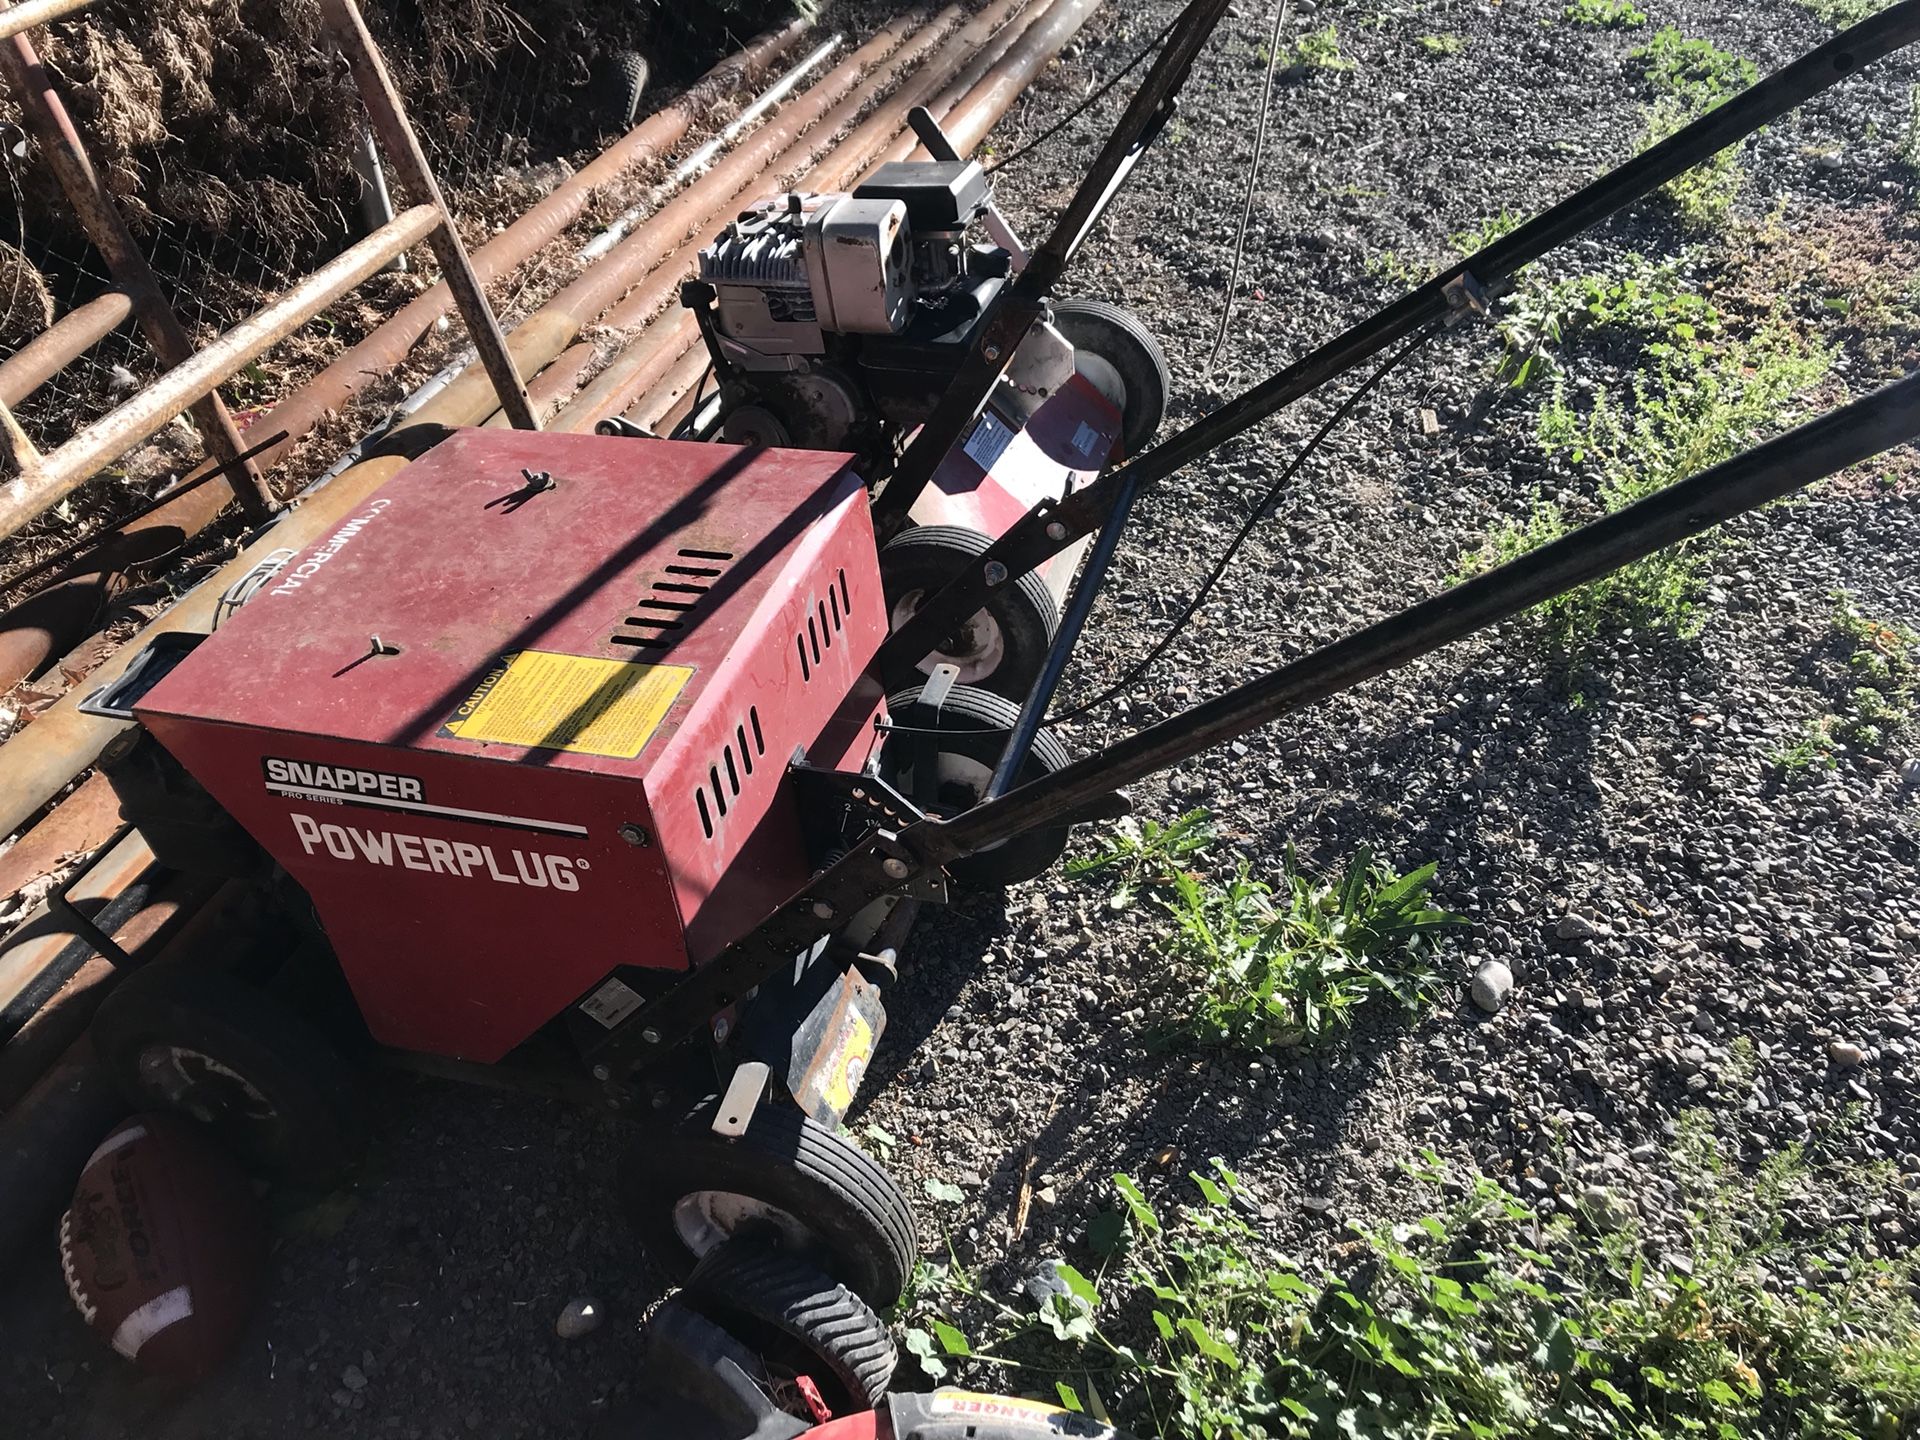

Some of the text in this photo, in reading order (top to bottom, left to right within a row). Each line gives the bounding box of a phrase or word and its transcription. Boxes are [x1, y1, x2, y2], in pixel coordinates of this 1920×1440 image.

[458, 668, 505, 716] CAUTION
[267, 758, 423, 802] SNAPPER
[281, 790, 344, 806] PRO SERIES
[844, 803, 852, 812] 2
[952, 1399, 1047, 1423] DANGER
